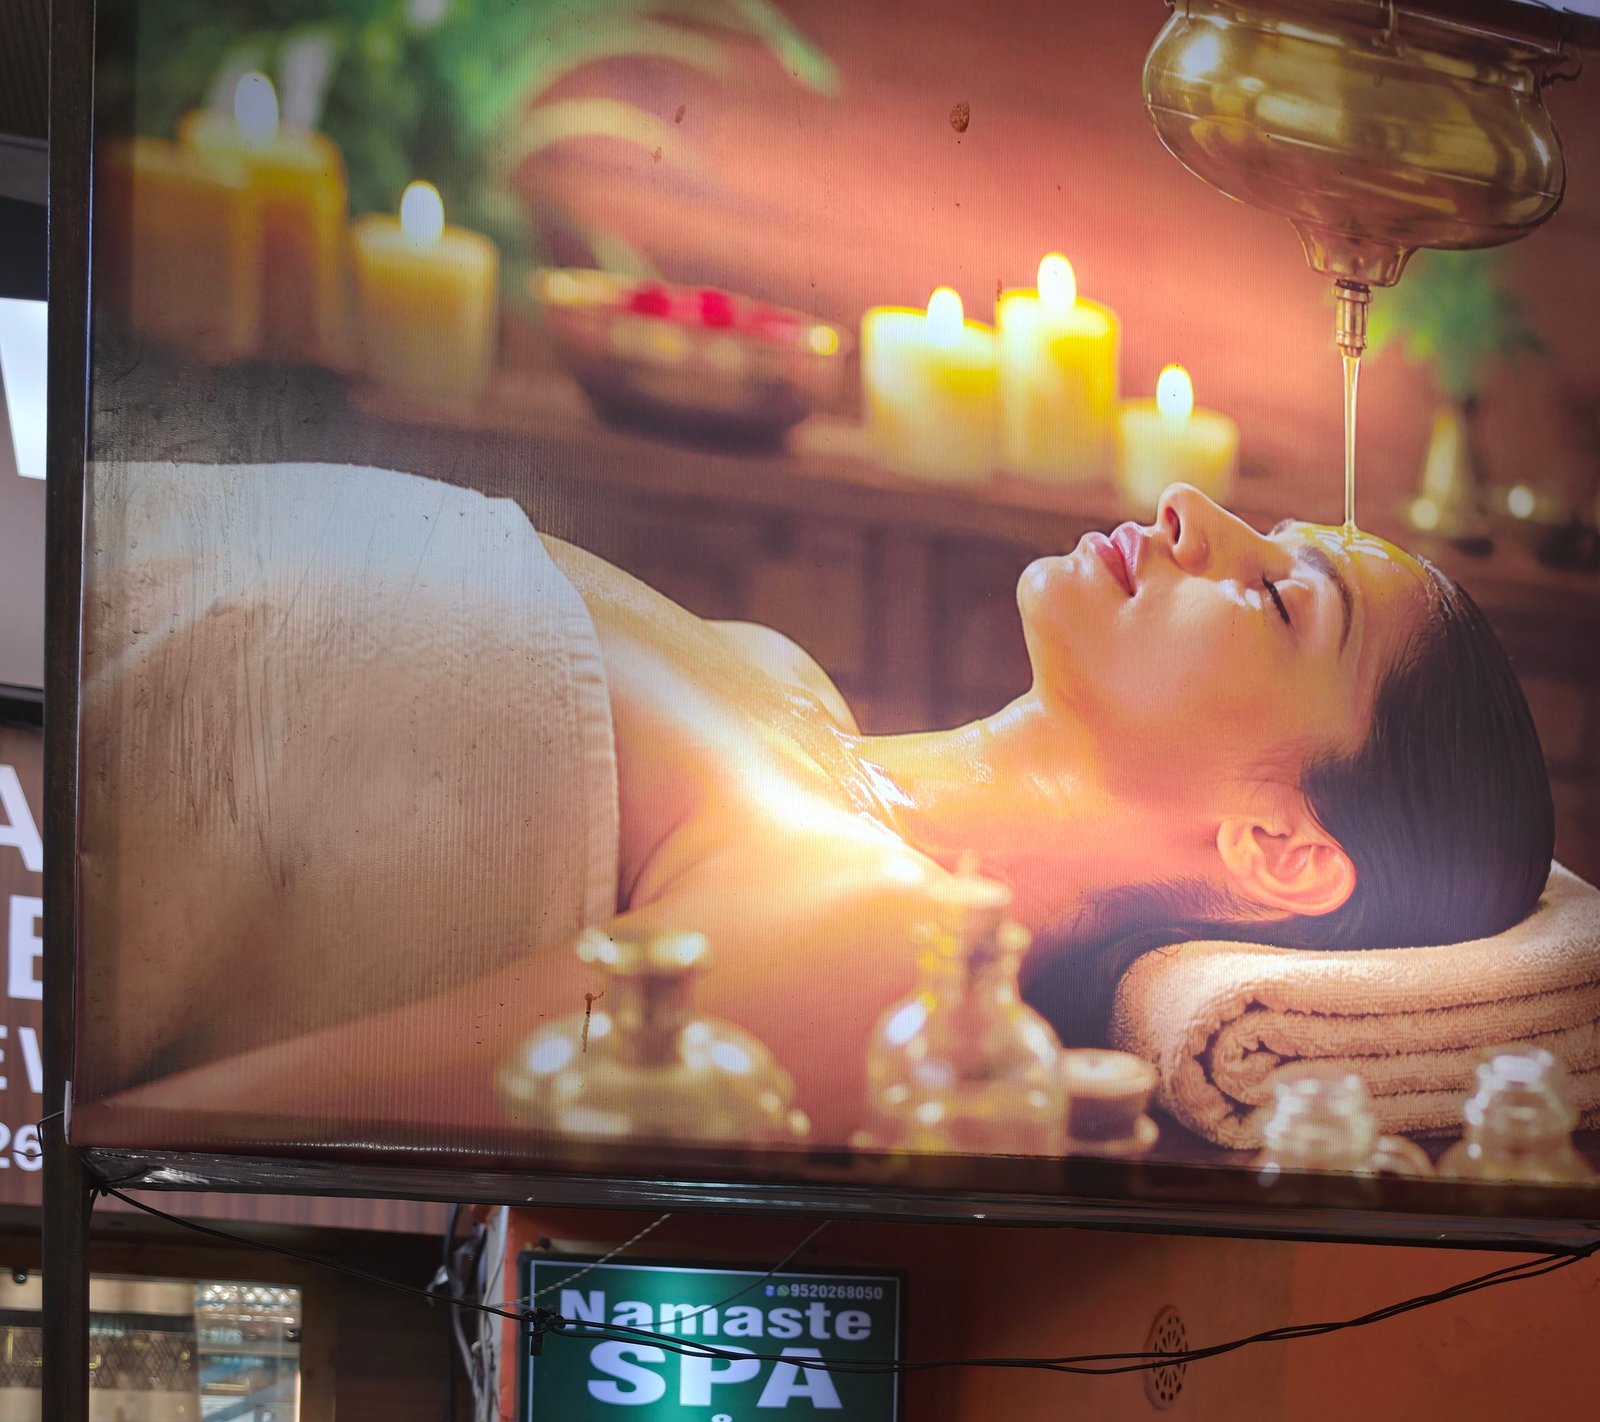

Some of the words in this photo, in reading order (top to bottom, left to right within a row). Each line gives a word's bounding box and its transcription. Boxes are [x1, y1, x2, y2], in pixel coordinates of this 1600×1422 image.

[559, 1288, 872, 1341] Namaste
[790, 1284, 883, 1299] 9520268050
[587, 1338, 843, 1409] SPA
